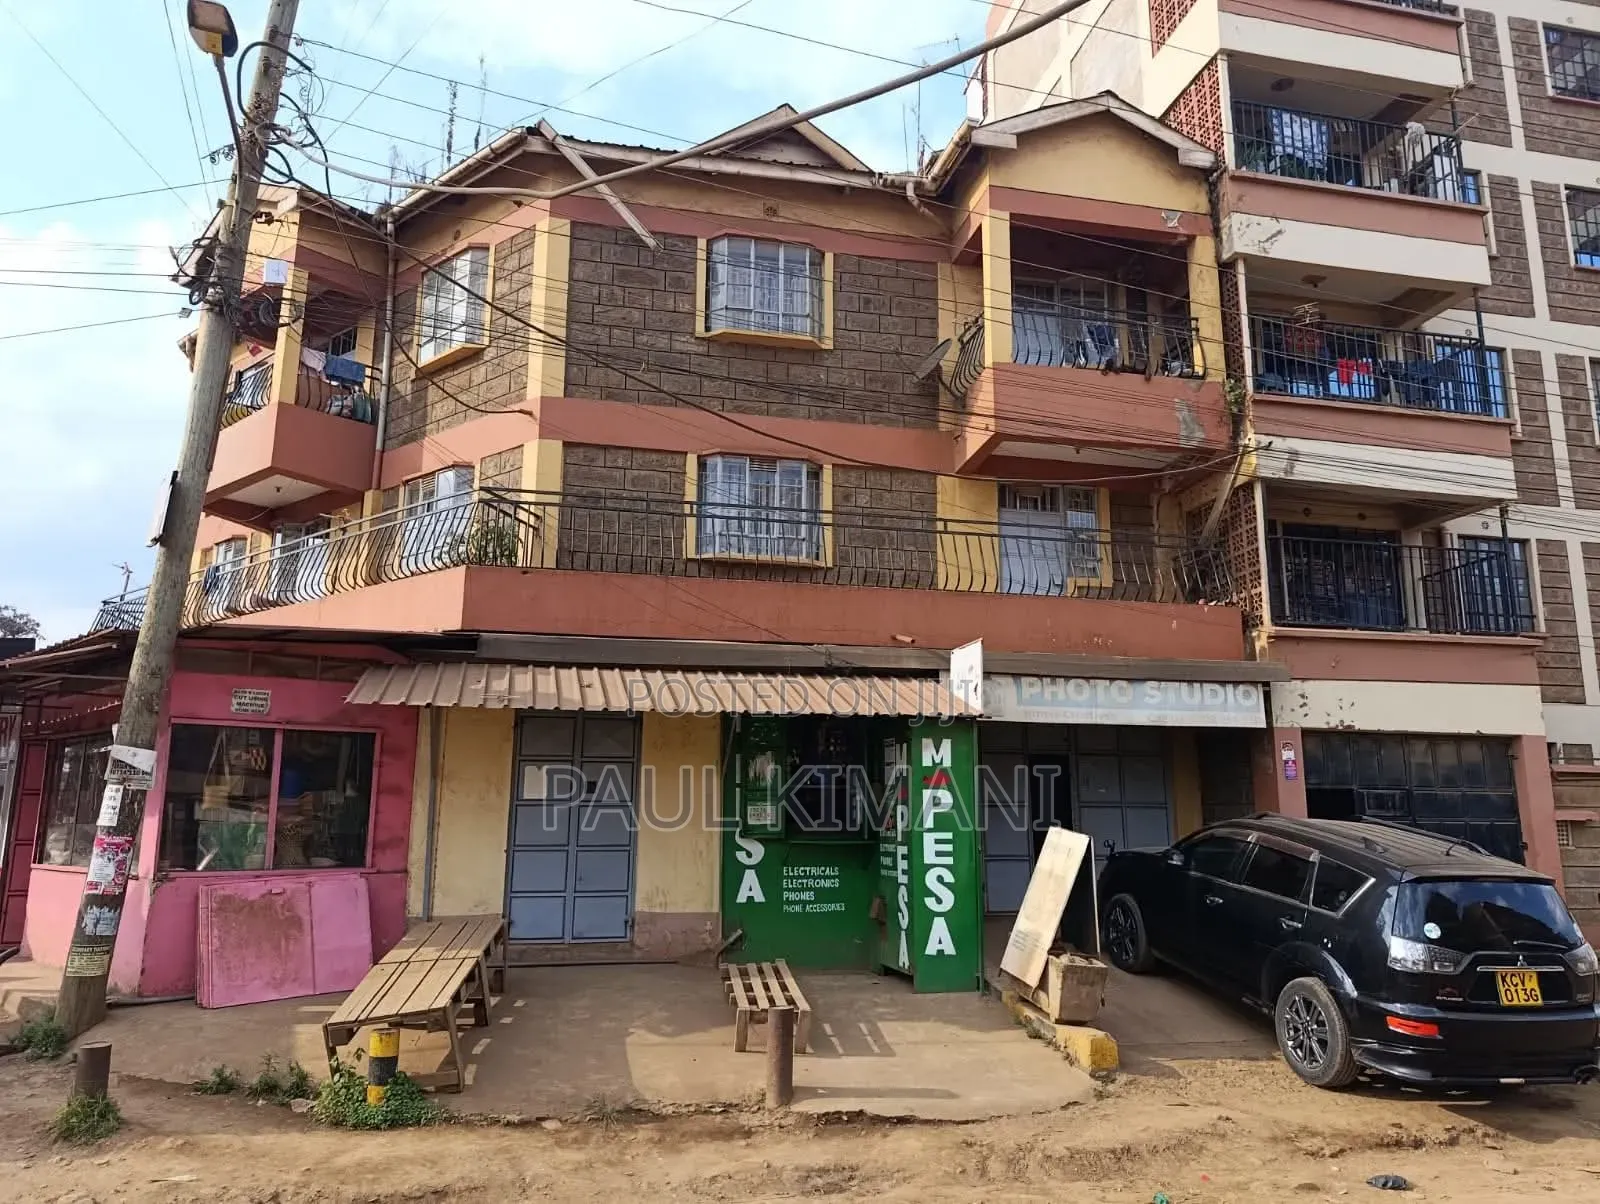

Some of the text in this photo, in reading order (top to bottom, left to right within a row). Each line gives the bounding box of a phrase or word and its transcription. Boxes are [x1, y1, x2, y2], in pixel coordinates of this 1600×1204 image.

[1021, 677, 1260, 706] PHOTO STUDIO
[783, 866, 840, 876] ELECTRICALS
[782, 879, 840, 889] ELECTRONICS
[783, 891, 816, 901] PHONES
[783, 903, 846, 913] PHONE ACCESSORIES
[1500, 973, 1526, 988] KCV
[1504, 988, 1540, 1004] 013G
